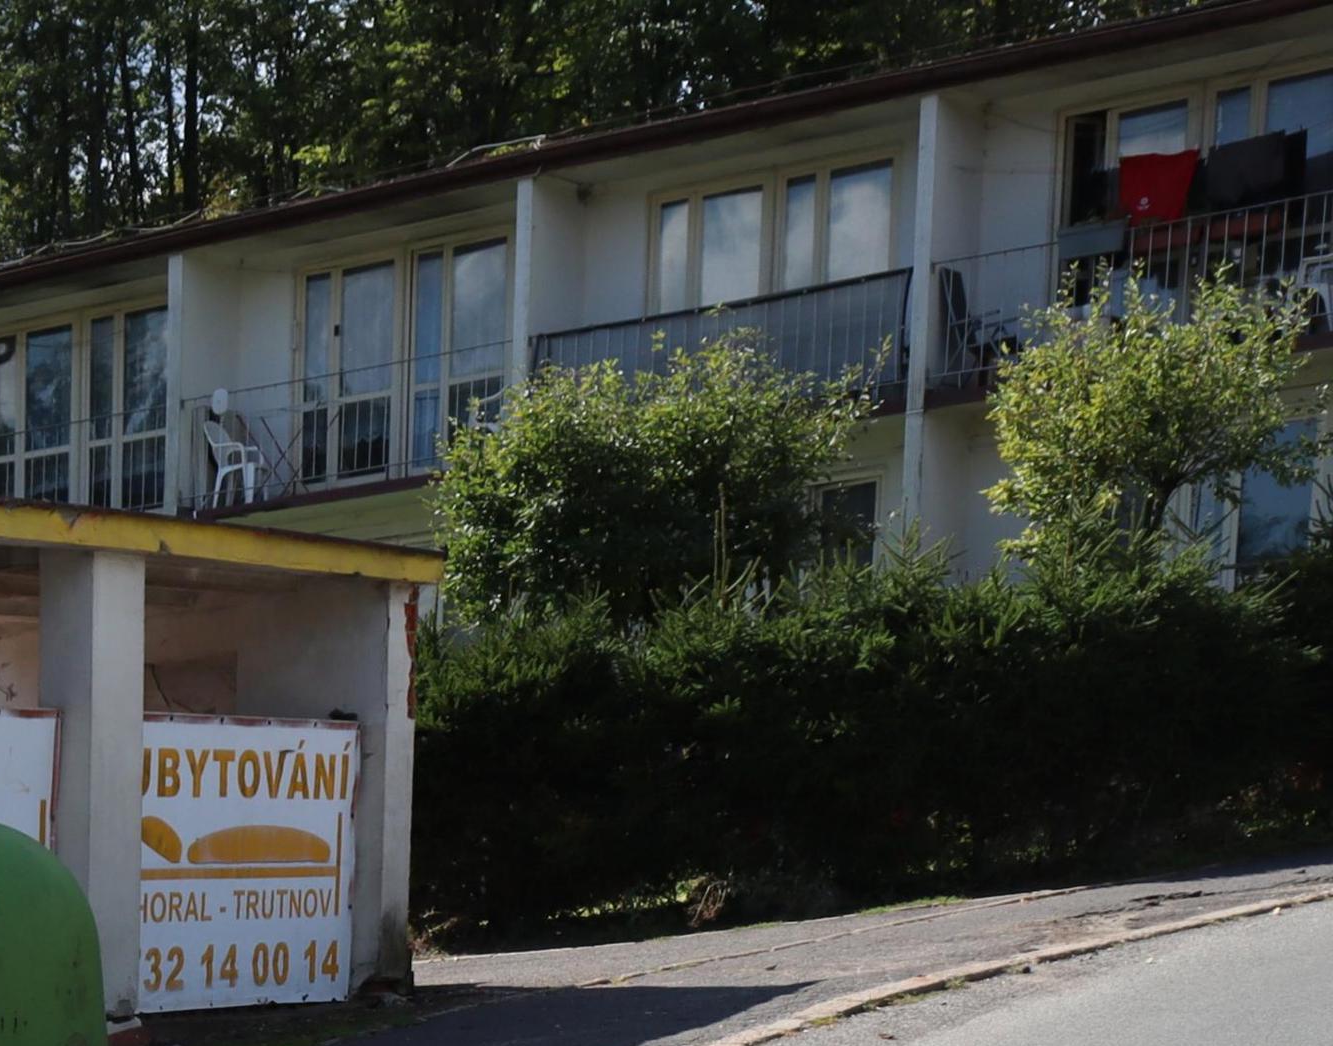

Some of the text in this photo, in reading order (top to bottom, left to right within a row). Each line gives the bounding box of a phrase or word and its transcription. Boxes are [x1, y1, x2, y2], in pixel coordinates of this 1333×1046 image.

[233, 888, 332, 920] TRUTNOV
[139, 940, 340, 992] 32 14 00 14
